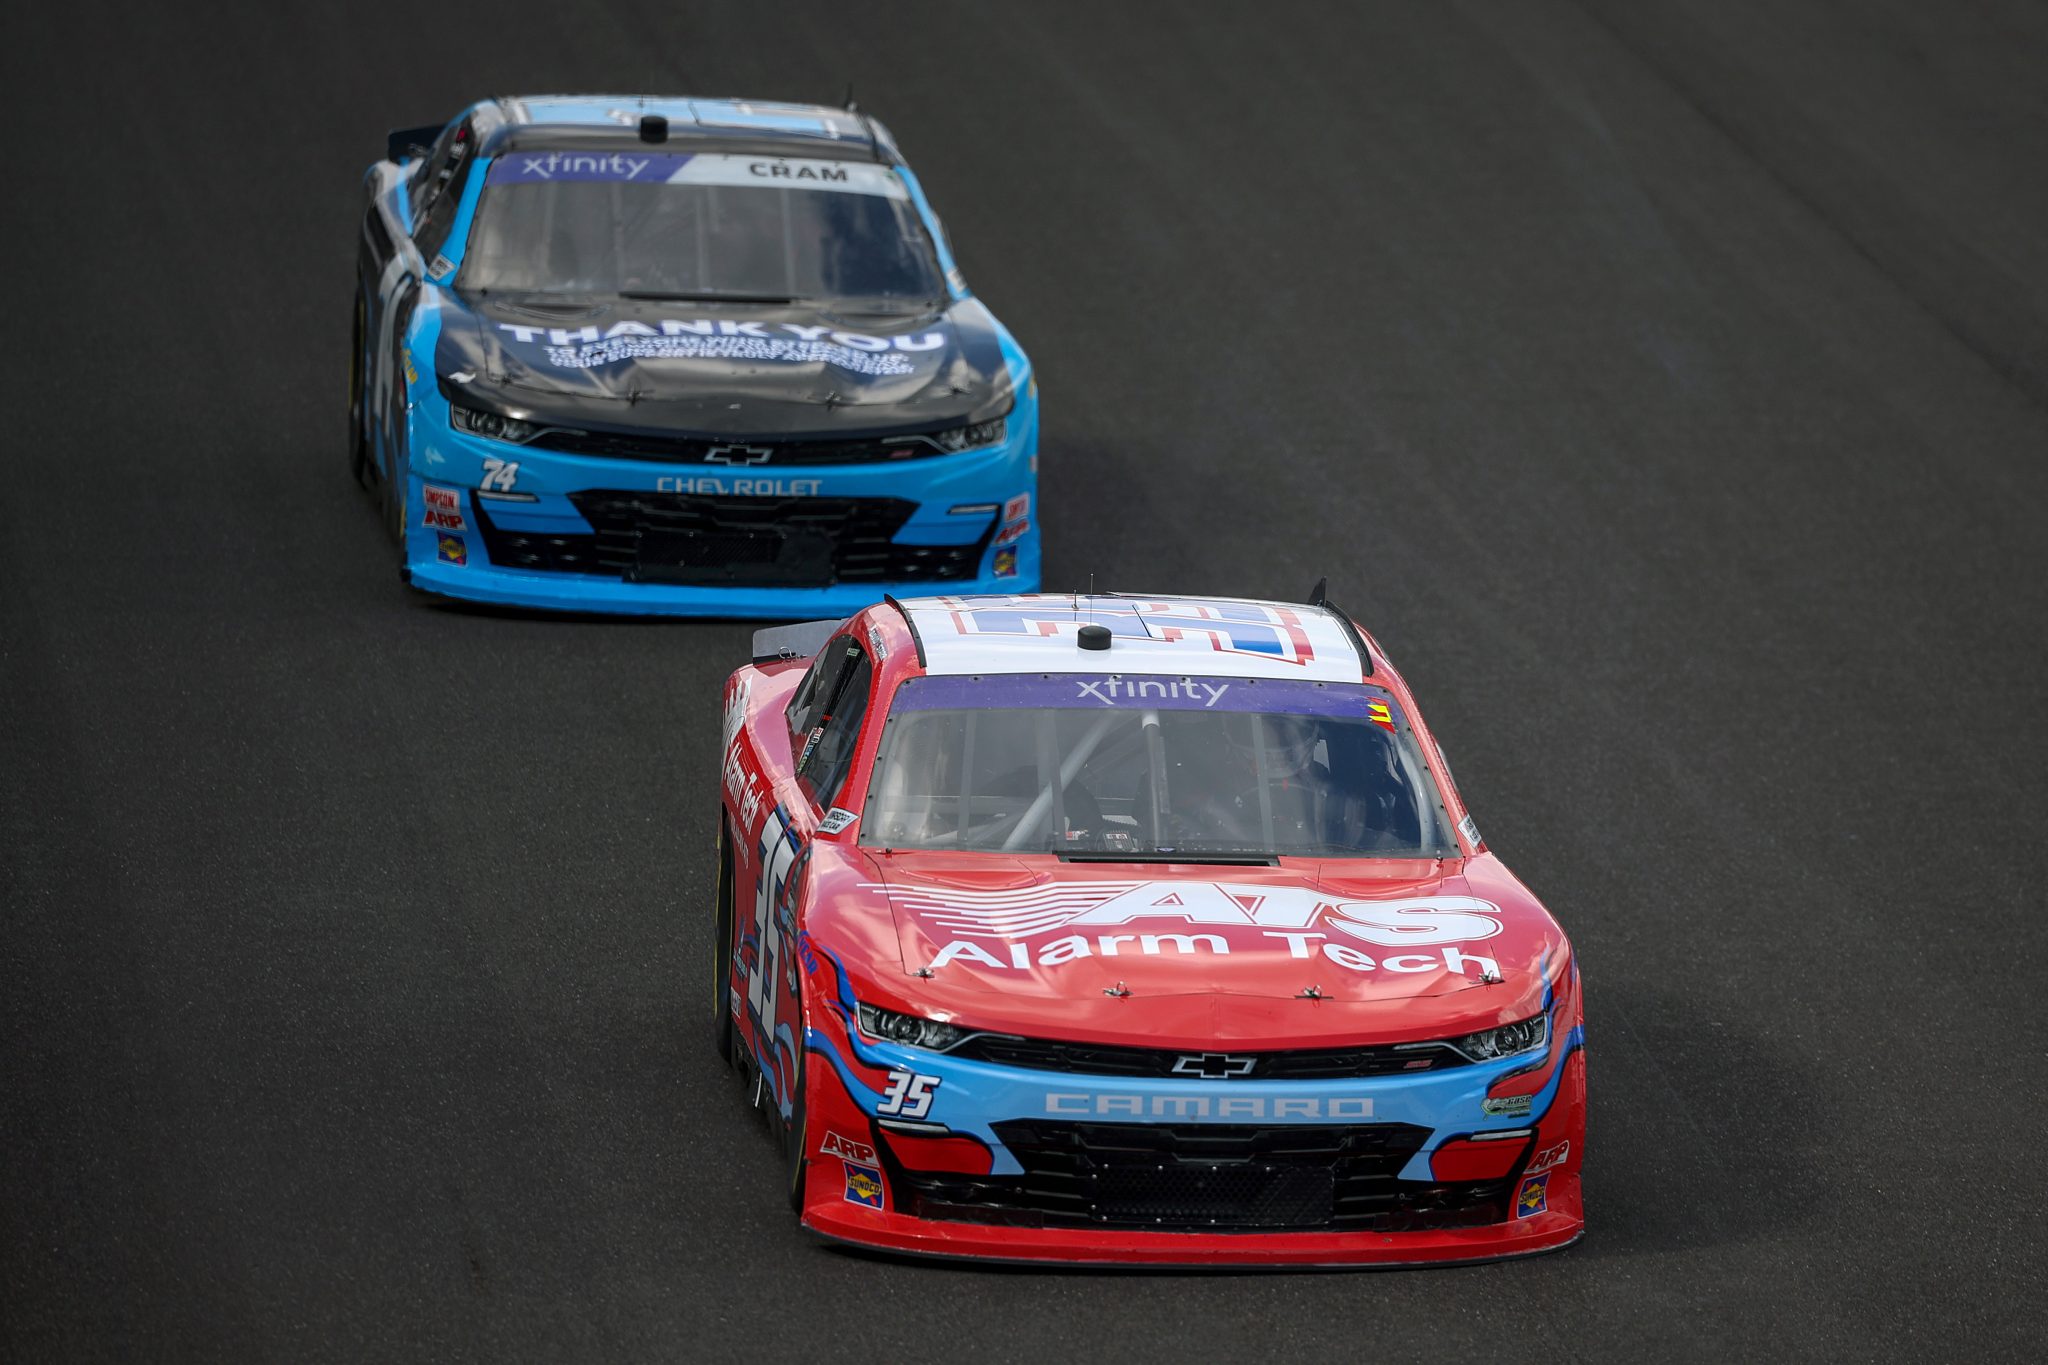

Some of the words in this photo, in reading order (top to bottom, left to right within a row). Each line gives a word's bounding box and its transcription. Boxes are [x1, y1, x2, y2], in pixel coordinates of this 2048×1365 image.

[521, 149, 650, 180] xfinity
[749, 162, 849, 183] CRAM
[498, 319, 769, 346] THANK
[779, 323, 945, 352] YOU
[480, 458, 519, 493] 74
[656, 476, 823, 498] CHEVROLET
[423, 509, 465, 531] ARP
[1076, 676, 1230, 707] xfinity
[1062, 881, 1504, 946] ATS
[928, 931, 1229, 971] Alarm
[1262, 931, 1502, 980] Tech
[876, 1070, 943, 1120] 35
[1045, 1093, 1374, 1118] CAMARO
[821, 1132, 878, 1167] ARP
[1526, 1141, 1569, 1174] ARP
[848, 1176, 881, 1195] SUNOCO
